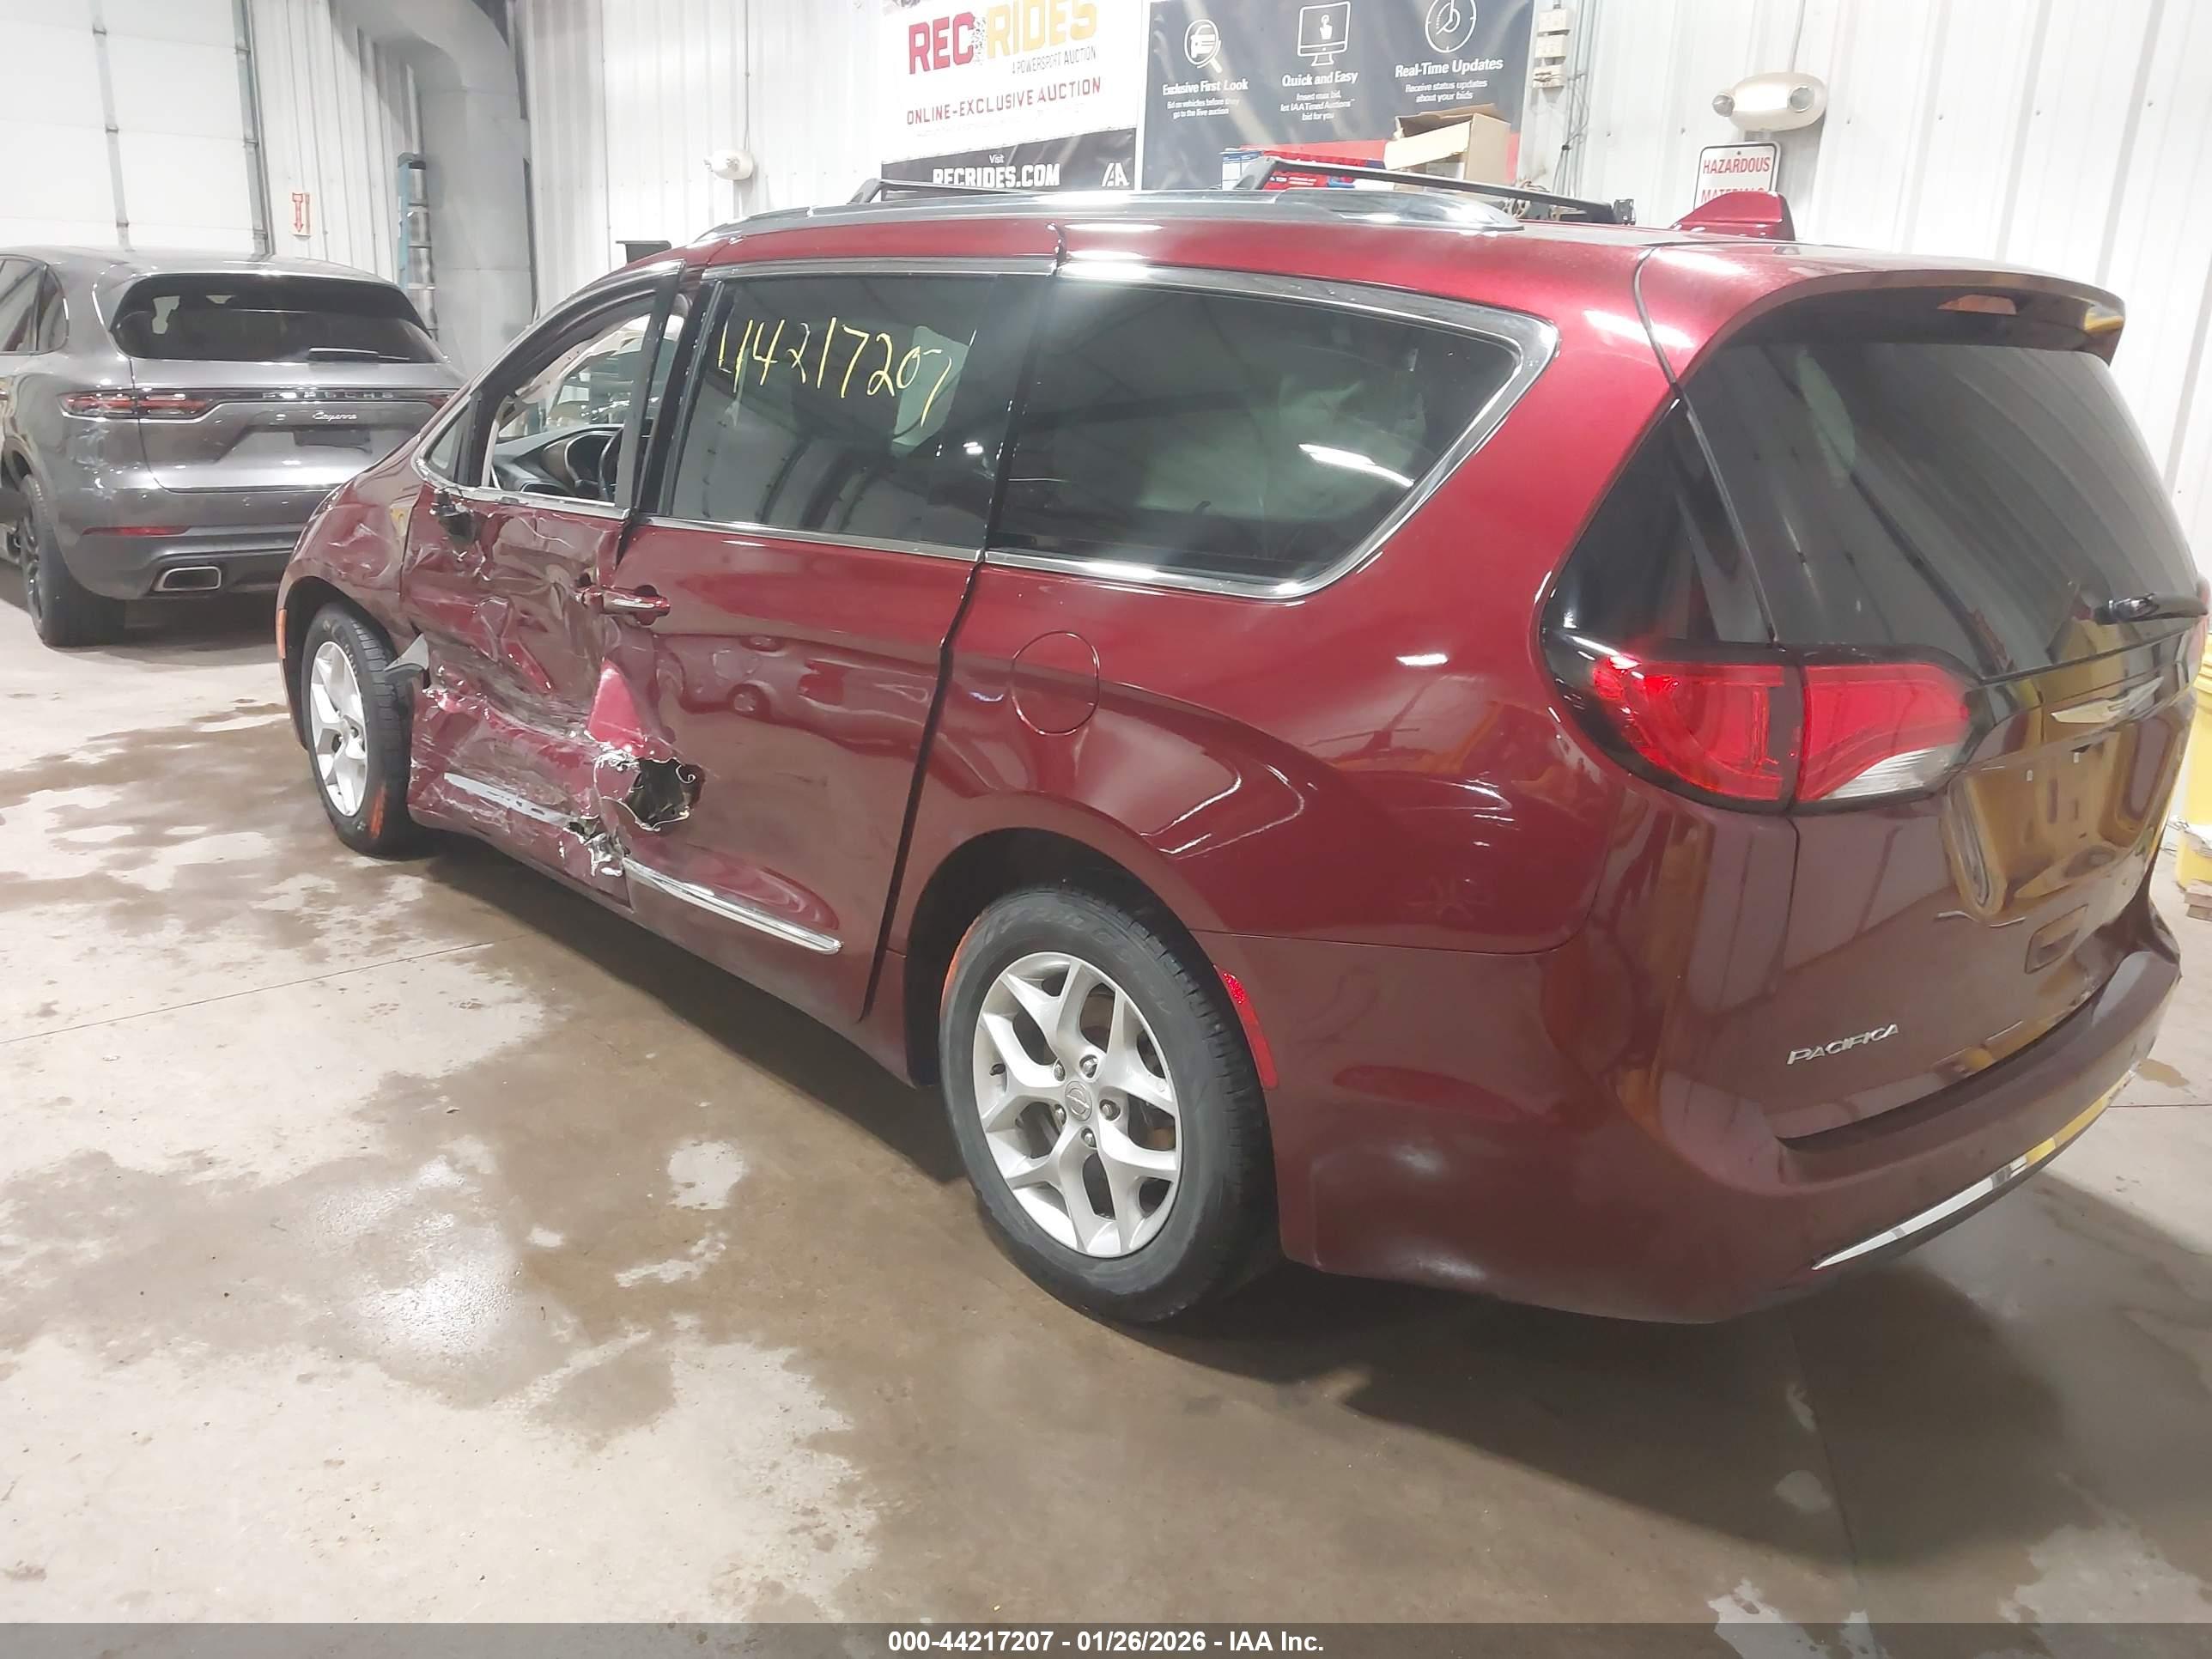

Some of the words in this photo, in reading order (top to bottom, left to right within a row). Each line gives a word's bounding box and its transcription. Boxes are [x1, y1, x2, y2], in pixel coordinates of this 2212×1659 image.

[1064, 46, 1097, 65] AUCTION
[1395, 62, 1449, 77] Real-Time
[1452, 58, 1504, 75] Updates
[1163, 82, 1200, 95] Exclusive
[1200, 80, 1220, 92] First
[1224, 78, 1249, 90] Look
[1282, 74, 1313, 87] Quick
[1314, 71, 1334, 85] and
[1334, 70, 1358, 84] Easy
[1405, 83, 1431, 93] Receive
[1432, 82, 1455, 91] status
[1456, 80, 1488, 90] updates
[907, 89, 1034, 125] ONLINE-EXCLUSIVE
[1037, 76, 1101, 103] AUCTION
[988, 154, 1006, 164] Visit
[1703, 157, 1771, 173] HAZARDOUS
[933, 163, 1060, 188] RECRIDES.COM
[1787, 1024, 1899, 1065] PACIFICA
